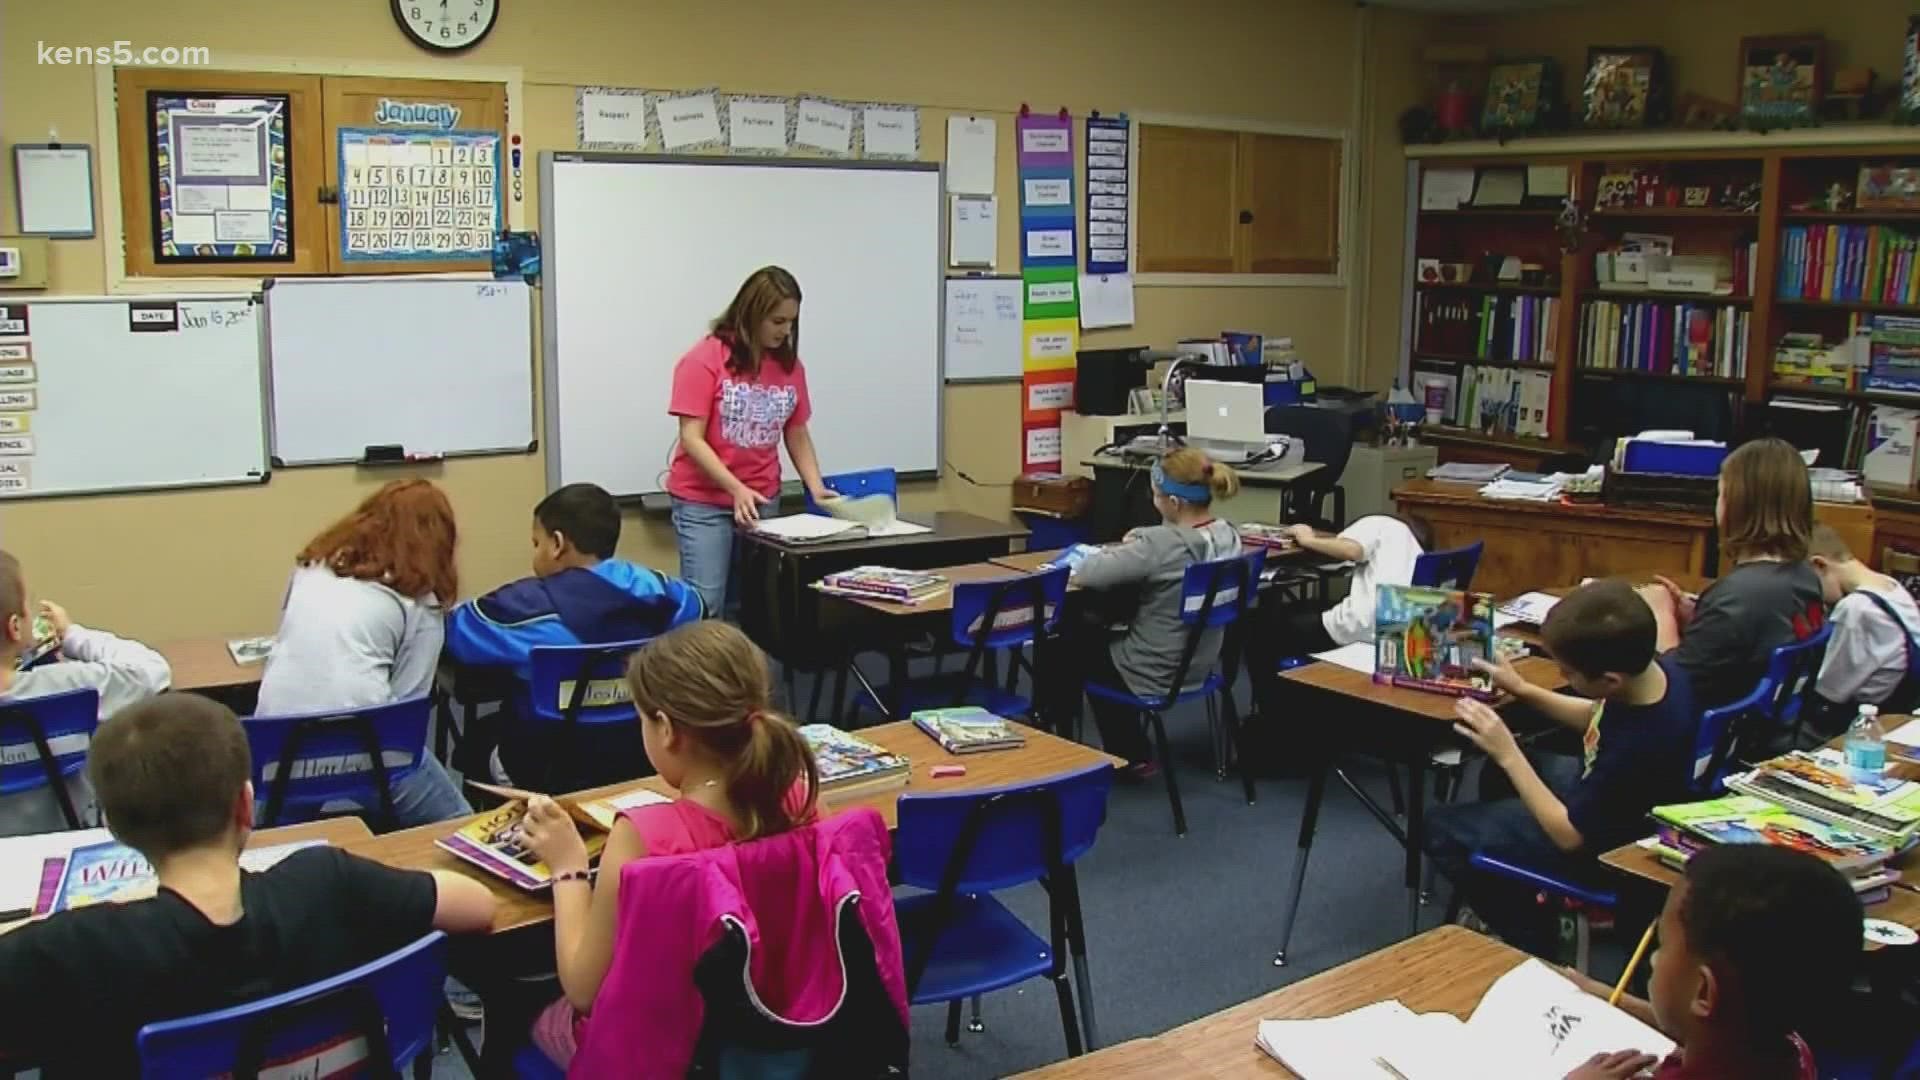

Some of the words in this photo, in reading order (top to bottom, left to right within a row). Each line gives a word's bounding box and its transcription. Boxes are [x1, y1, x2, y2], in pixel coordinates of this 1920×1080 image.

[412, 8, 420, 20] 8
[470, 11, 479, 22] 4
[424, 21, 433, 32] 7
[440, 27, 450, 38] 6
[457, 23, 467, 35] 5
[377, 101, 459, 128] January
[438, 150, 444, 164] 1
[459, 150, 466, 162] 2
[479, 150, 487, 162] 3
[353, 170, 361, 184] 4
[375, 170, 382, 184] 5
[396, 169, 405, 184] 6
[418, 169, 425, 184] 7
[438, 170, 447, 184] 8
[459, 170, 468, 183] 9
[478, 170, 491, 184] 10
[352, 190, 365, 204] 11
[375, 189, 387, 204] 12
[395, 189, 408, 203] 13
[415, 190, 429, 206] 14
[437, 190, 450, 204] 15
[457, 191, 470, 204] 16
[478, 189, 491, 204] 17
[350, 212, 364, 226] 18
[373, 211, 386, 226] 19
[394, 212, 410, 226] 20
[415, 211, 428, 226] 21
[437, 210, 450, 225] 22
[458, 211, 471, 225] 23
[478, 211, 490, 226] 24
[351, 233, 366, 248] 25
[394, 232, 408, 247] 27
[416, 232, 430, 247] 28
[437, 233, 450, 248] 29
[455, 233, 470, 247] 30
[477, 233, 490, 248] 31
